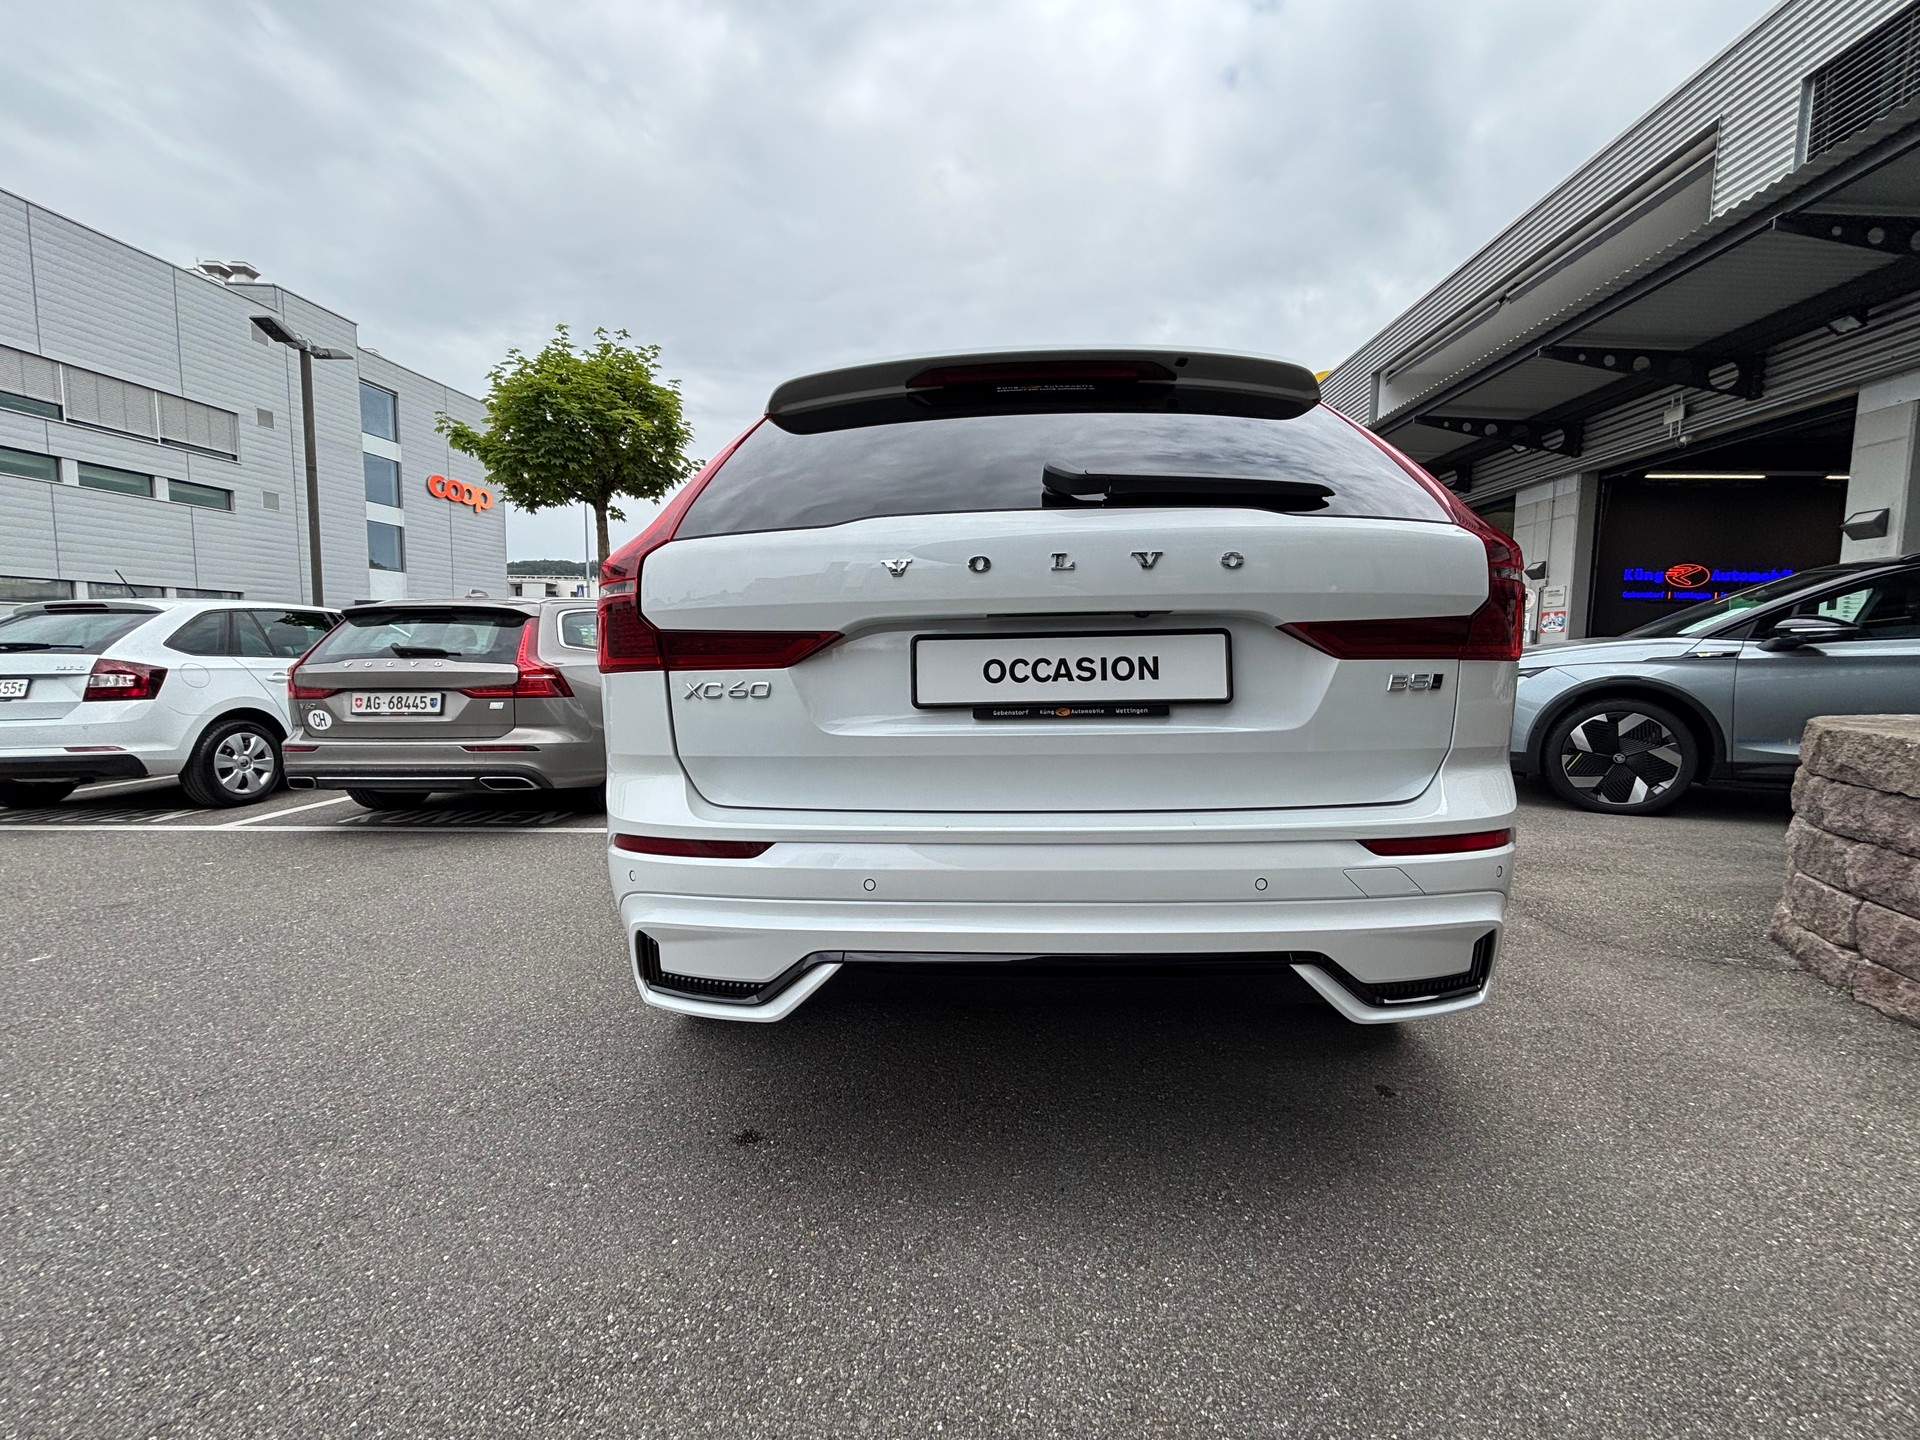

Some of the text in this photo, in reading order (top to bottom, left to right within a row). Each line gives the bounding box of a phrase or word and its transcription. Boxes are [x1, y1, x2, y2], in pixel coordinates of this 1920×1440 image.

[427, 474, 493, 513] coop
[881, 551, 1244, 578] VOLVO
[1623, 567, 1793, 583] Küng Automobil
[983, 656, 1159, 684] OCCASION
[1115, 707, 1149, 715] Wettingen
[312, 712, 328, 727] CH
[337, 810, 576, 824] KUNDEN
